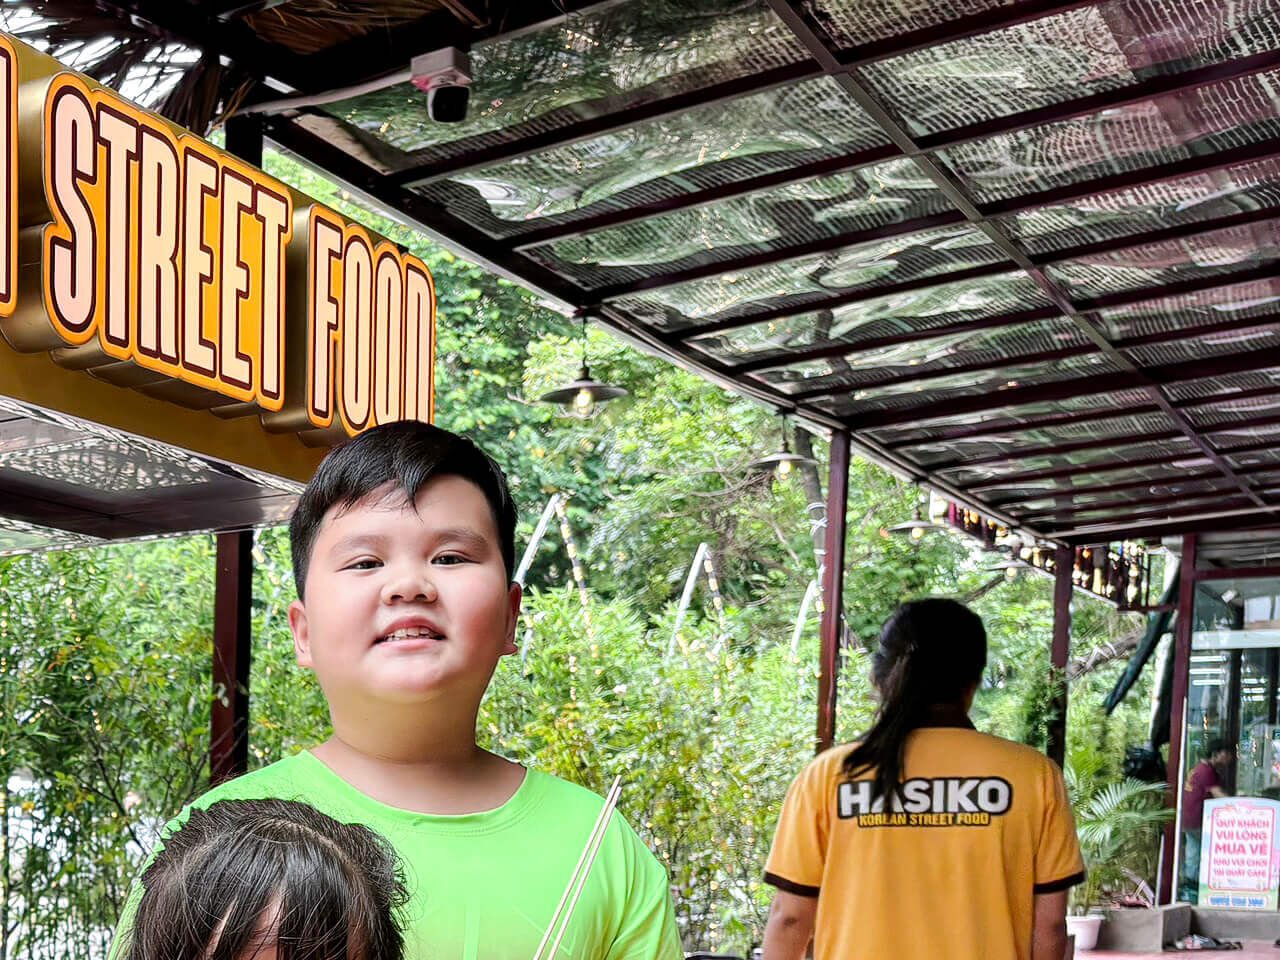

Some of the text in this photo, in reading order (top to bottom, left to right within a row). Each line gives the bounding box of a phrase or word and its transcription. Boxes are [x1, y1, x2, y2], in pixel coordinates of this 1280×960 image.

[54, 90, 288, 397] STREET
[312, 218, 434, 428] FOOD
[910, 813, 954, 825] STREET
[957, 813, 989, 825] FOOD
[1215, 844, 1246, 855] MUA
